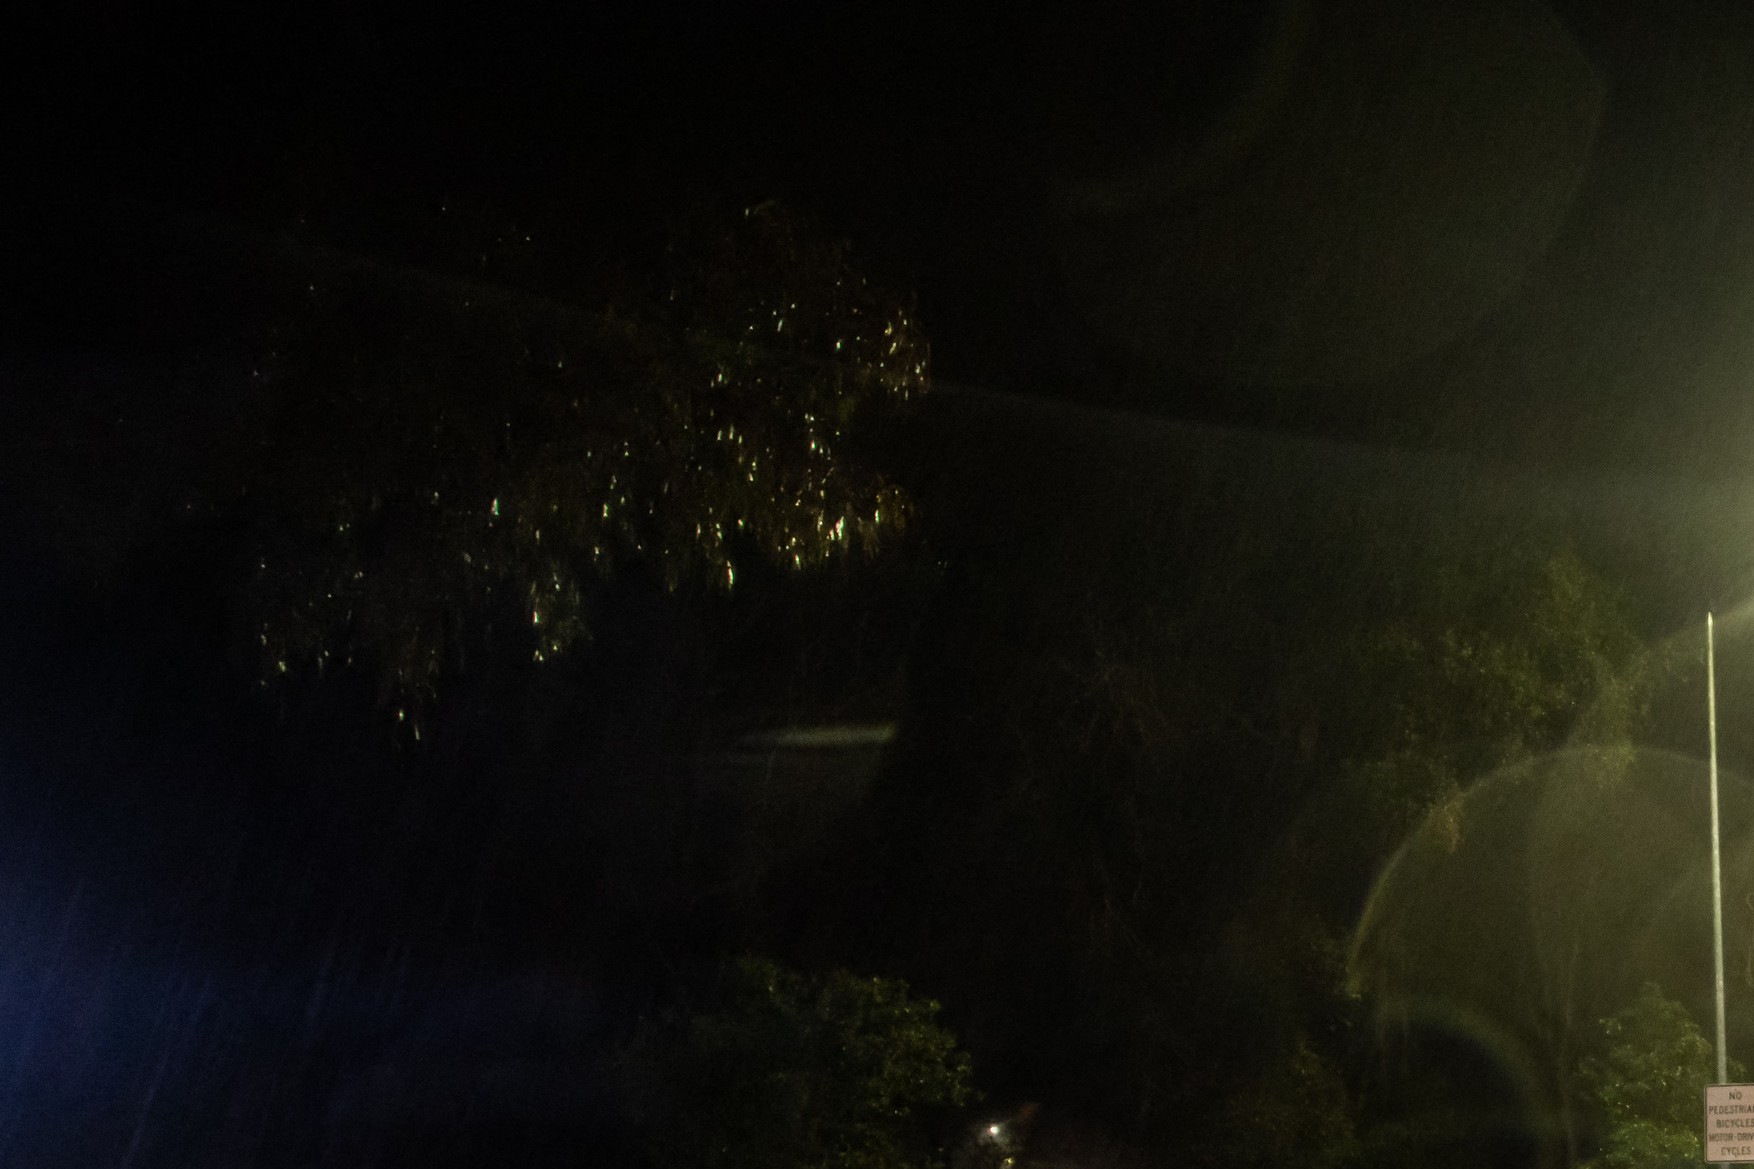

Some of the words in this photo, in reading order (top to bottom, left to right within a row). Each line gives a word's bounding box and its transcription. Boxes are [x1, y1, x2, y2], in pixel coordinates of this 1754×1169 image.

[1729, 1091, 1742, 1100] NO
[1716, 1119, 1754, 1128] BICYCLES
[1721, 1146, 1751, 1156] CYCLES
